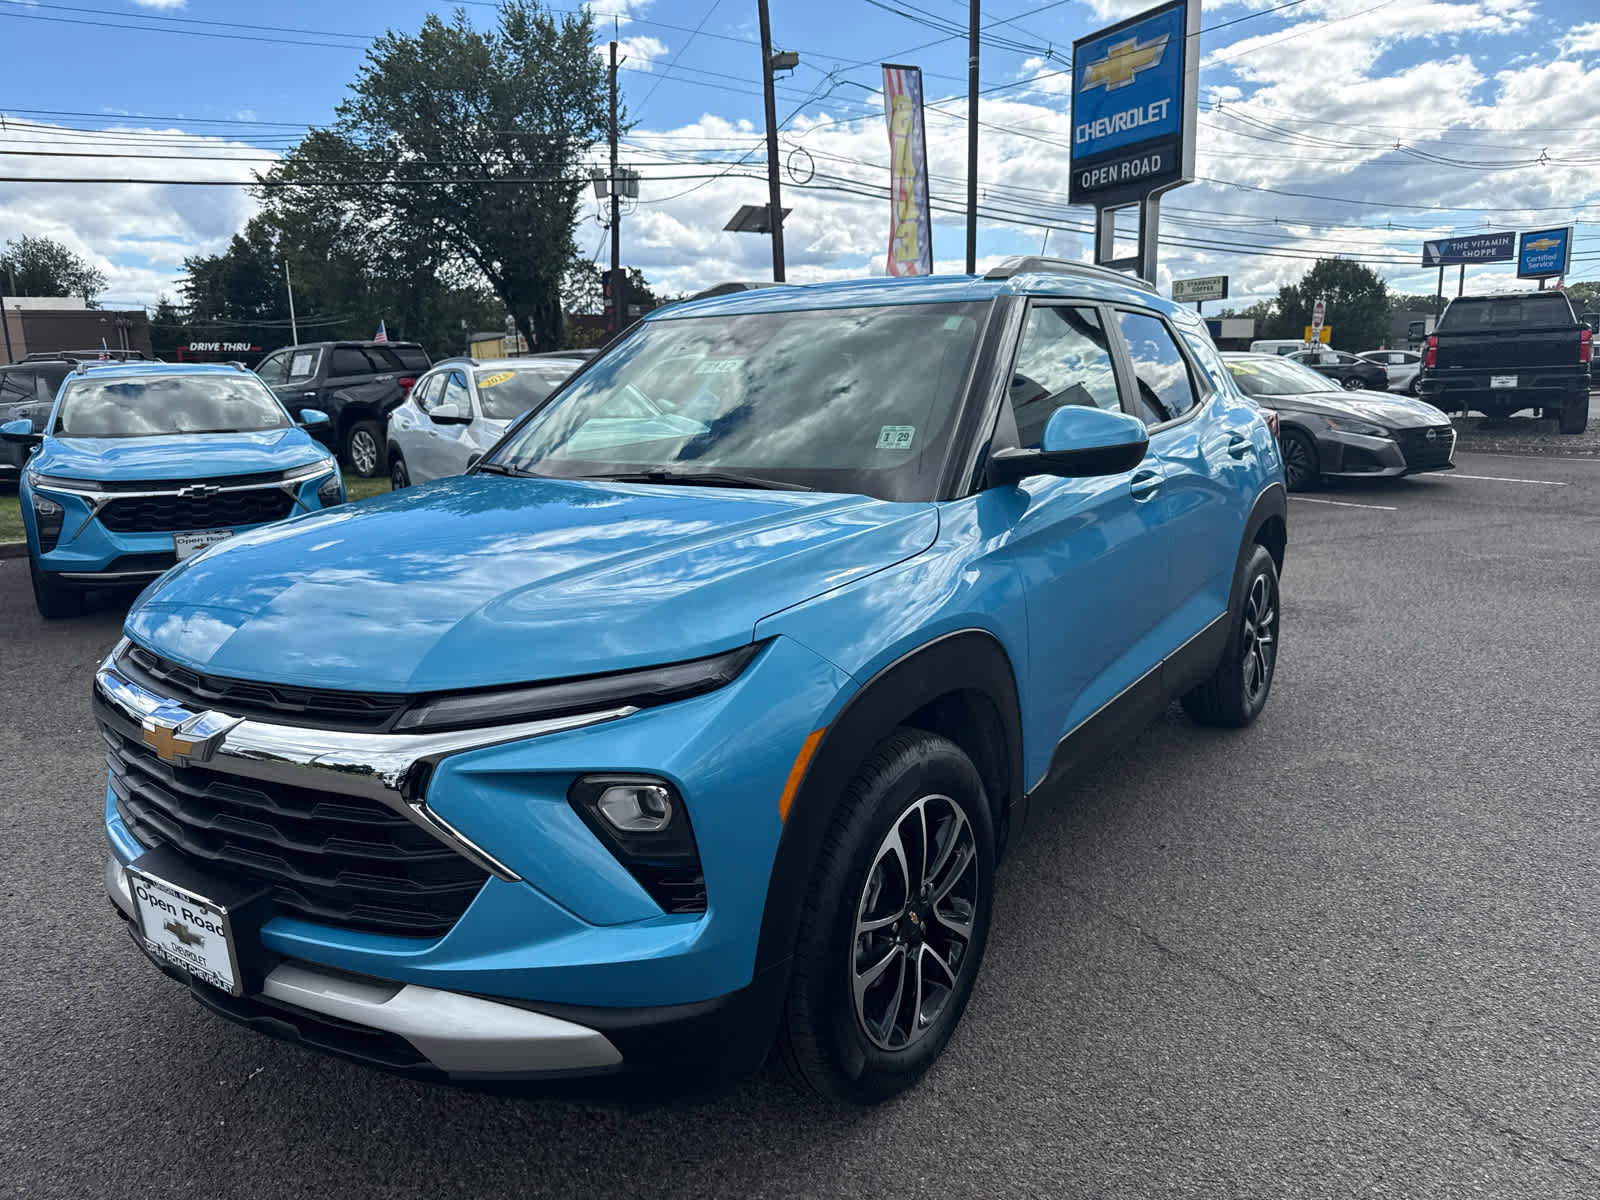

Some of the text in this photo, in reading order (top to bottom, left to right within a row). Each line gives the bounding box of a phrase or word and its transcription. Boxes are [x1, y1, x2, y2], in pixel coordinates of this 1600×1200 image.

[1076, 98, 1170, 144] CHEVROLET
[1082, 155, 1161, 188] OPEN ROAD
[1452, 237, 1509, 250] THE VITAMIN
[1462, 247, 1497, 257] SHOPPE
[1526, 253, 1557, 264] Certified
[1528, 260, 1554, 269] Service
[189, 342, 251, 351] DRIVE THRU
[897, 433, 909, 441] 29
[177, 537, 204, 545] Open
[136, 886, 177, 916] Open
[171, 942, 207, 967] CHEVROLET
[146, 942, 233, 994] OPEN ROAD CHEVROLET
